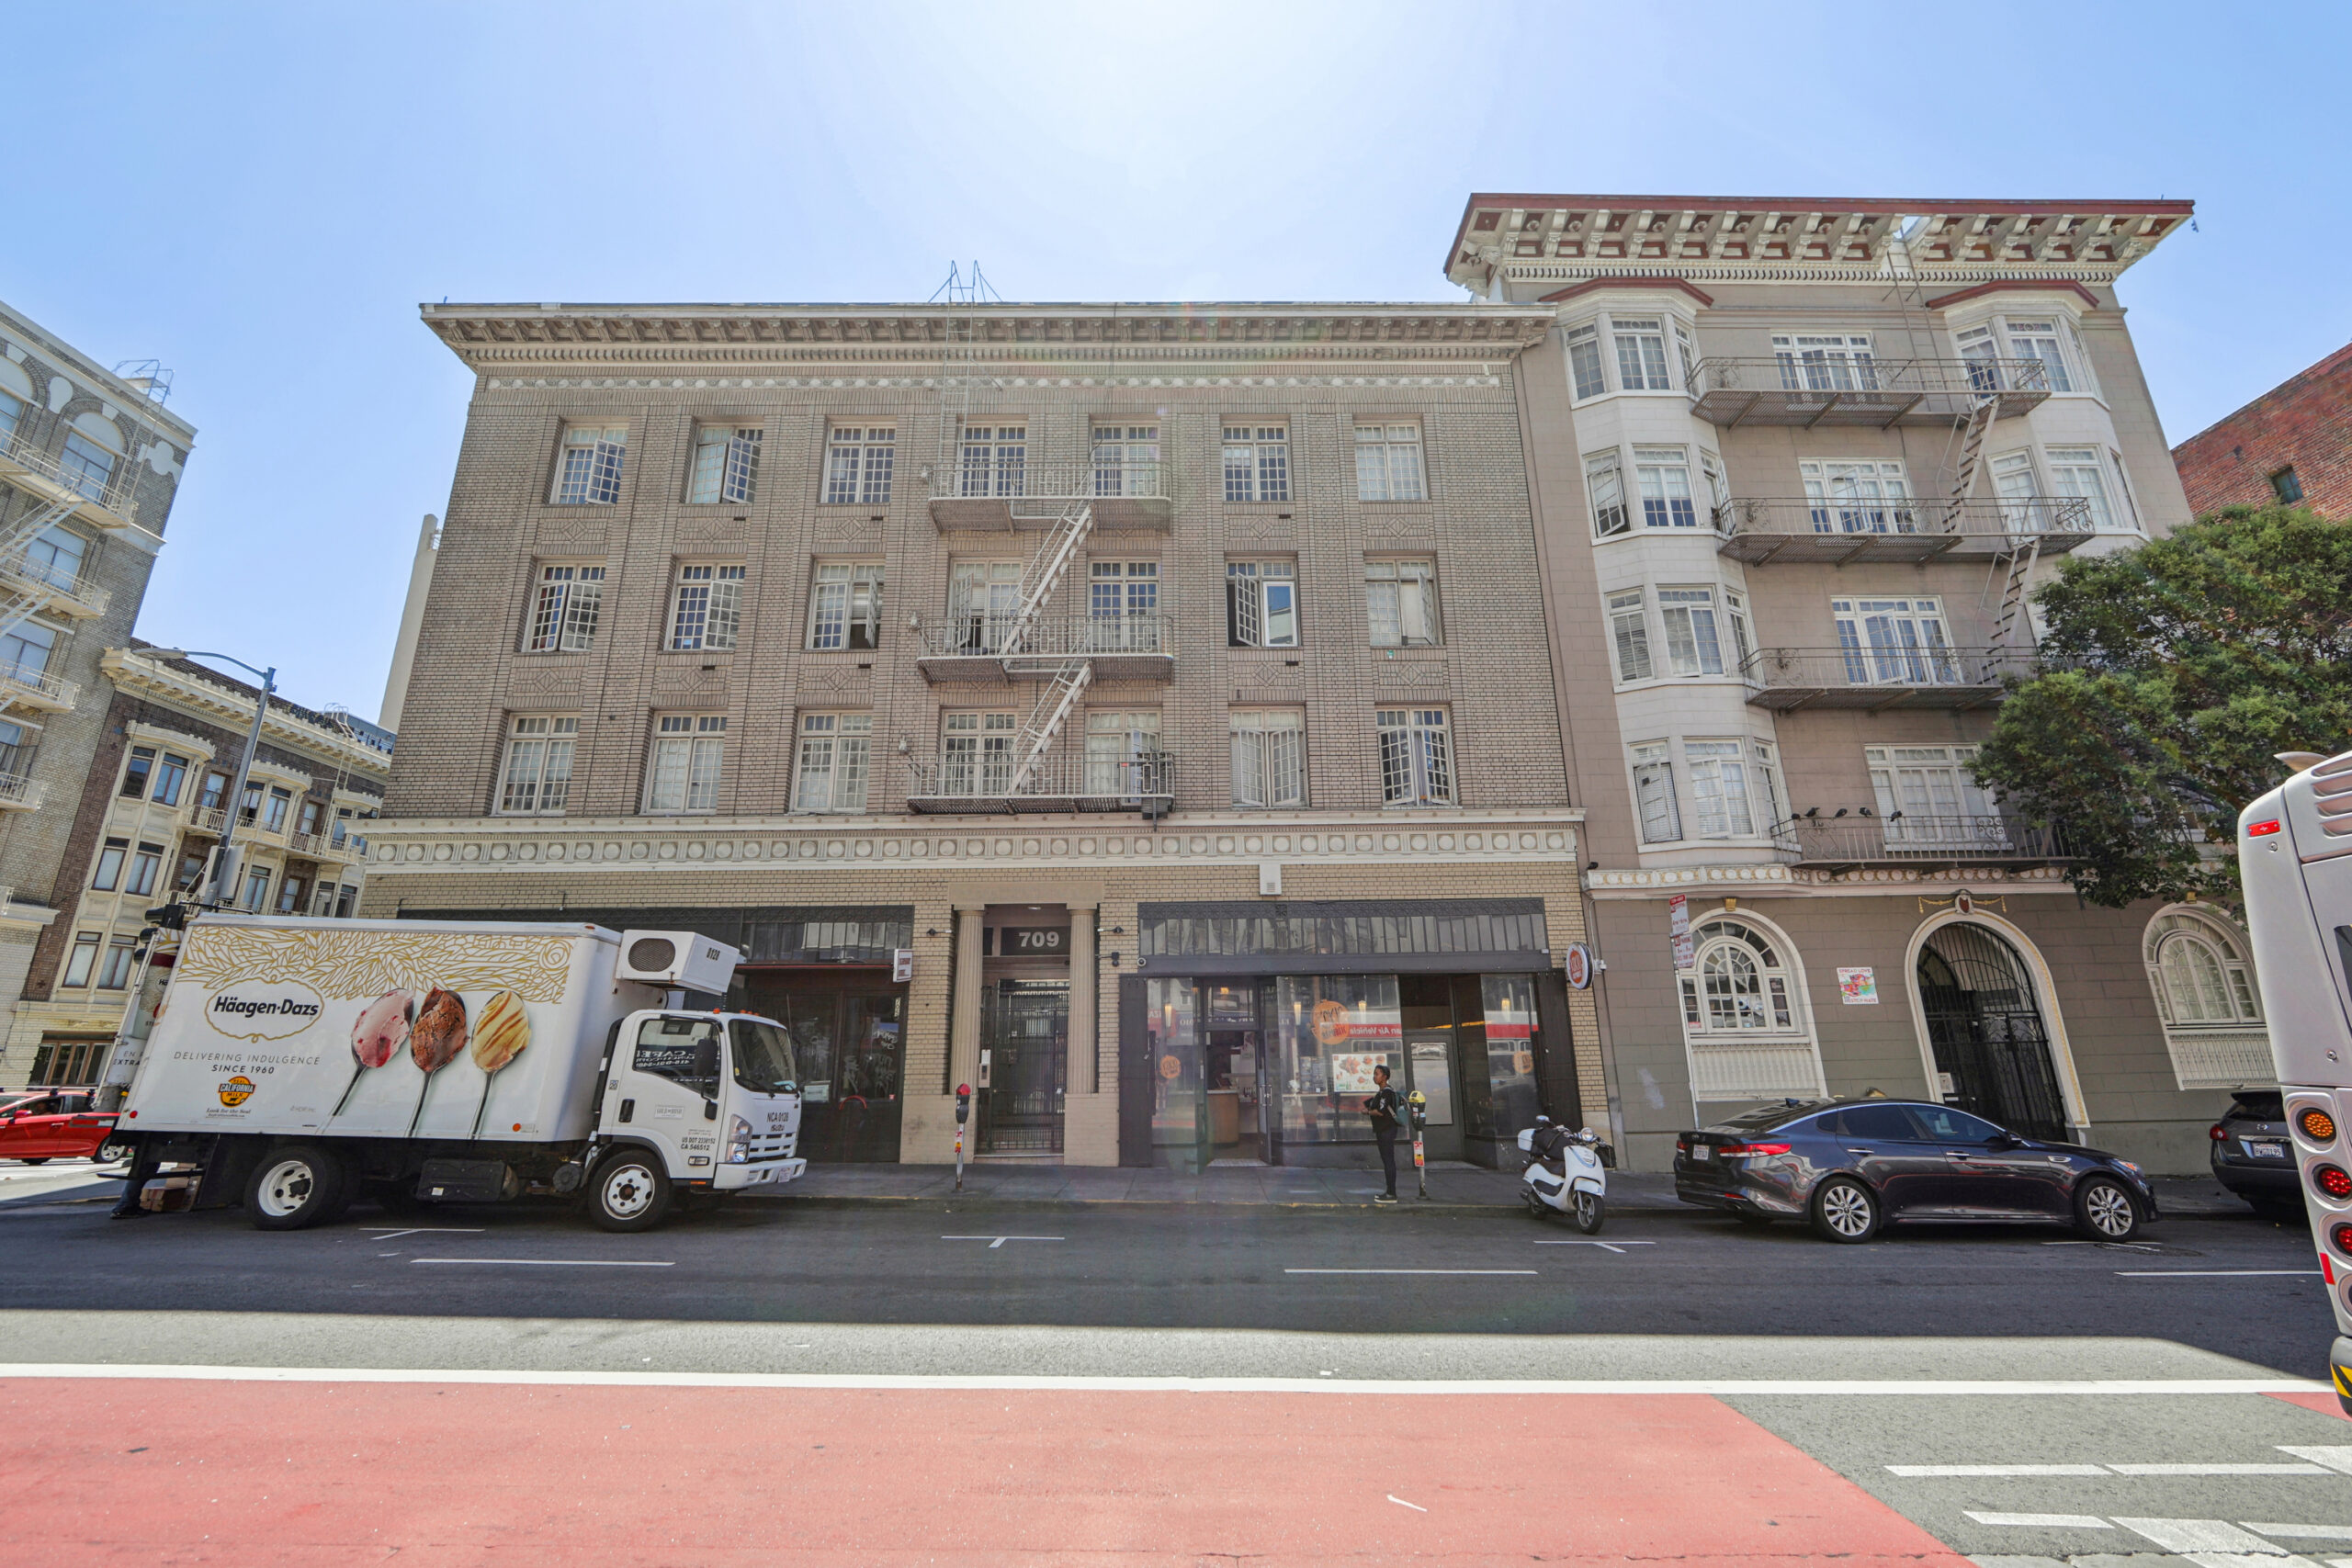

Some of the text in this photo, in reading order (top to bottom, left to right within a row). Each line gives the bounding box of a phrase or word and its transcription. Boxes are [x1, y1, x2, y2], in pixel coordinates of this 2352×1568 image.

[1018, 931, 1059, 947] 709
[213, 996, 320, 1018] Häagen-Dazs
[174, 1051, 321, 1066] DELIVERING INDULGENCE
[211, 1064, 275, 1075] SINCE 1960
[220, 1083, 254, 1093] CALIFORNIA
